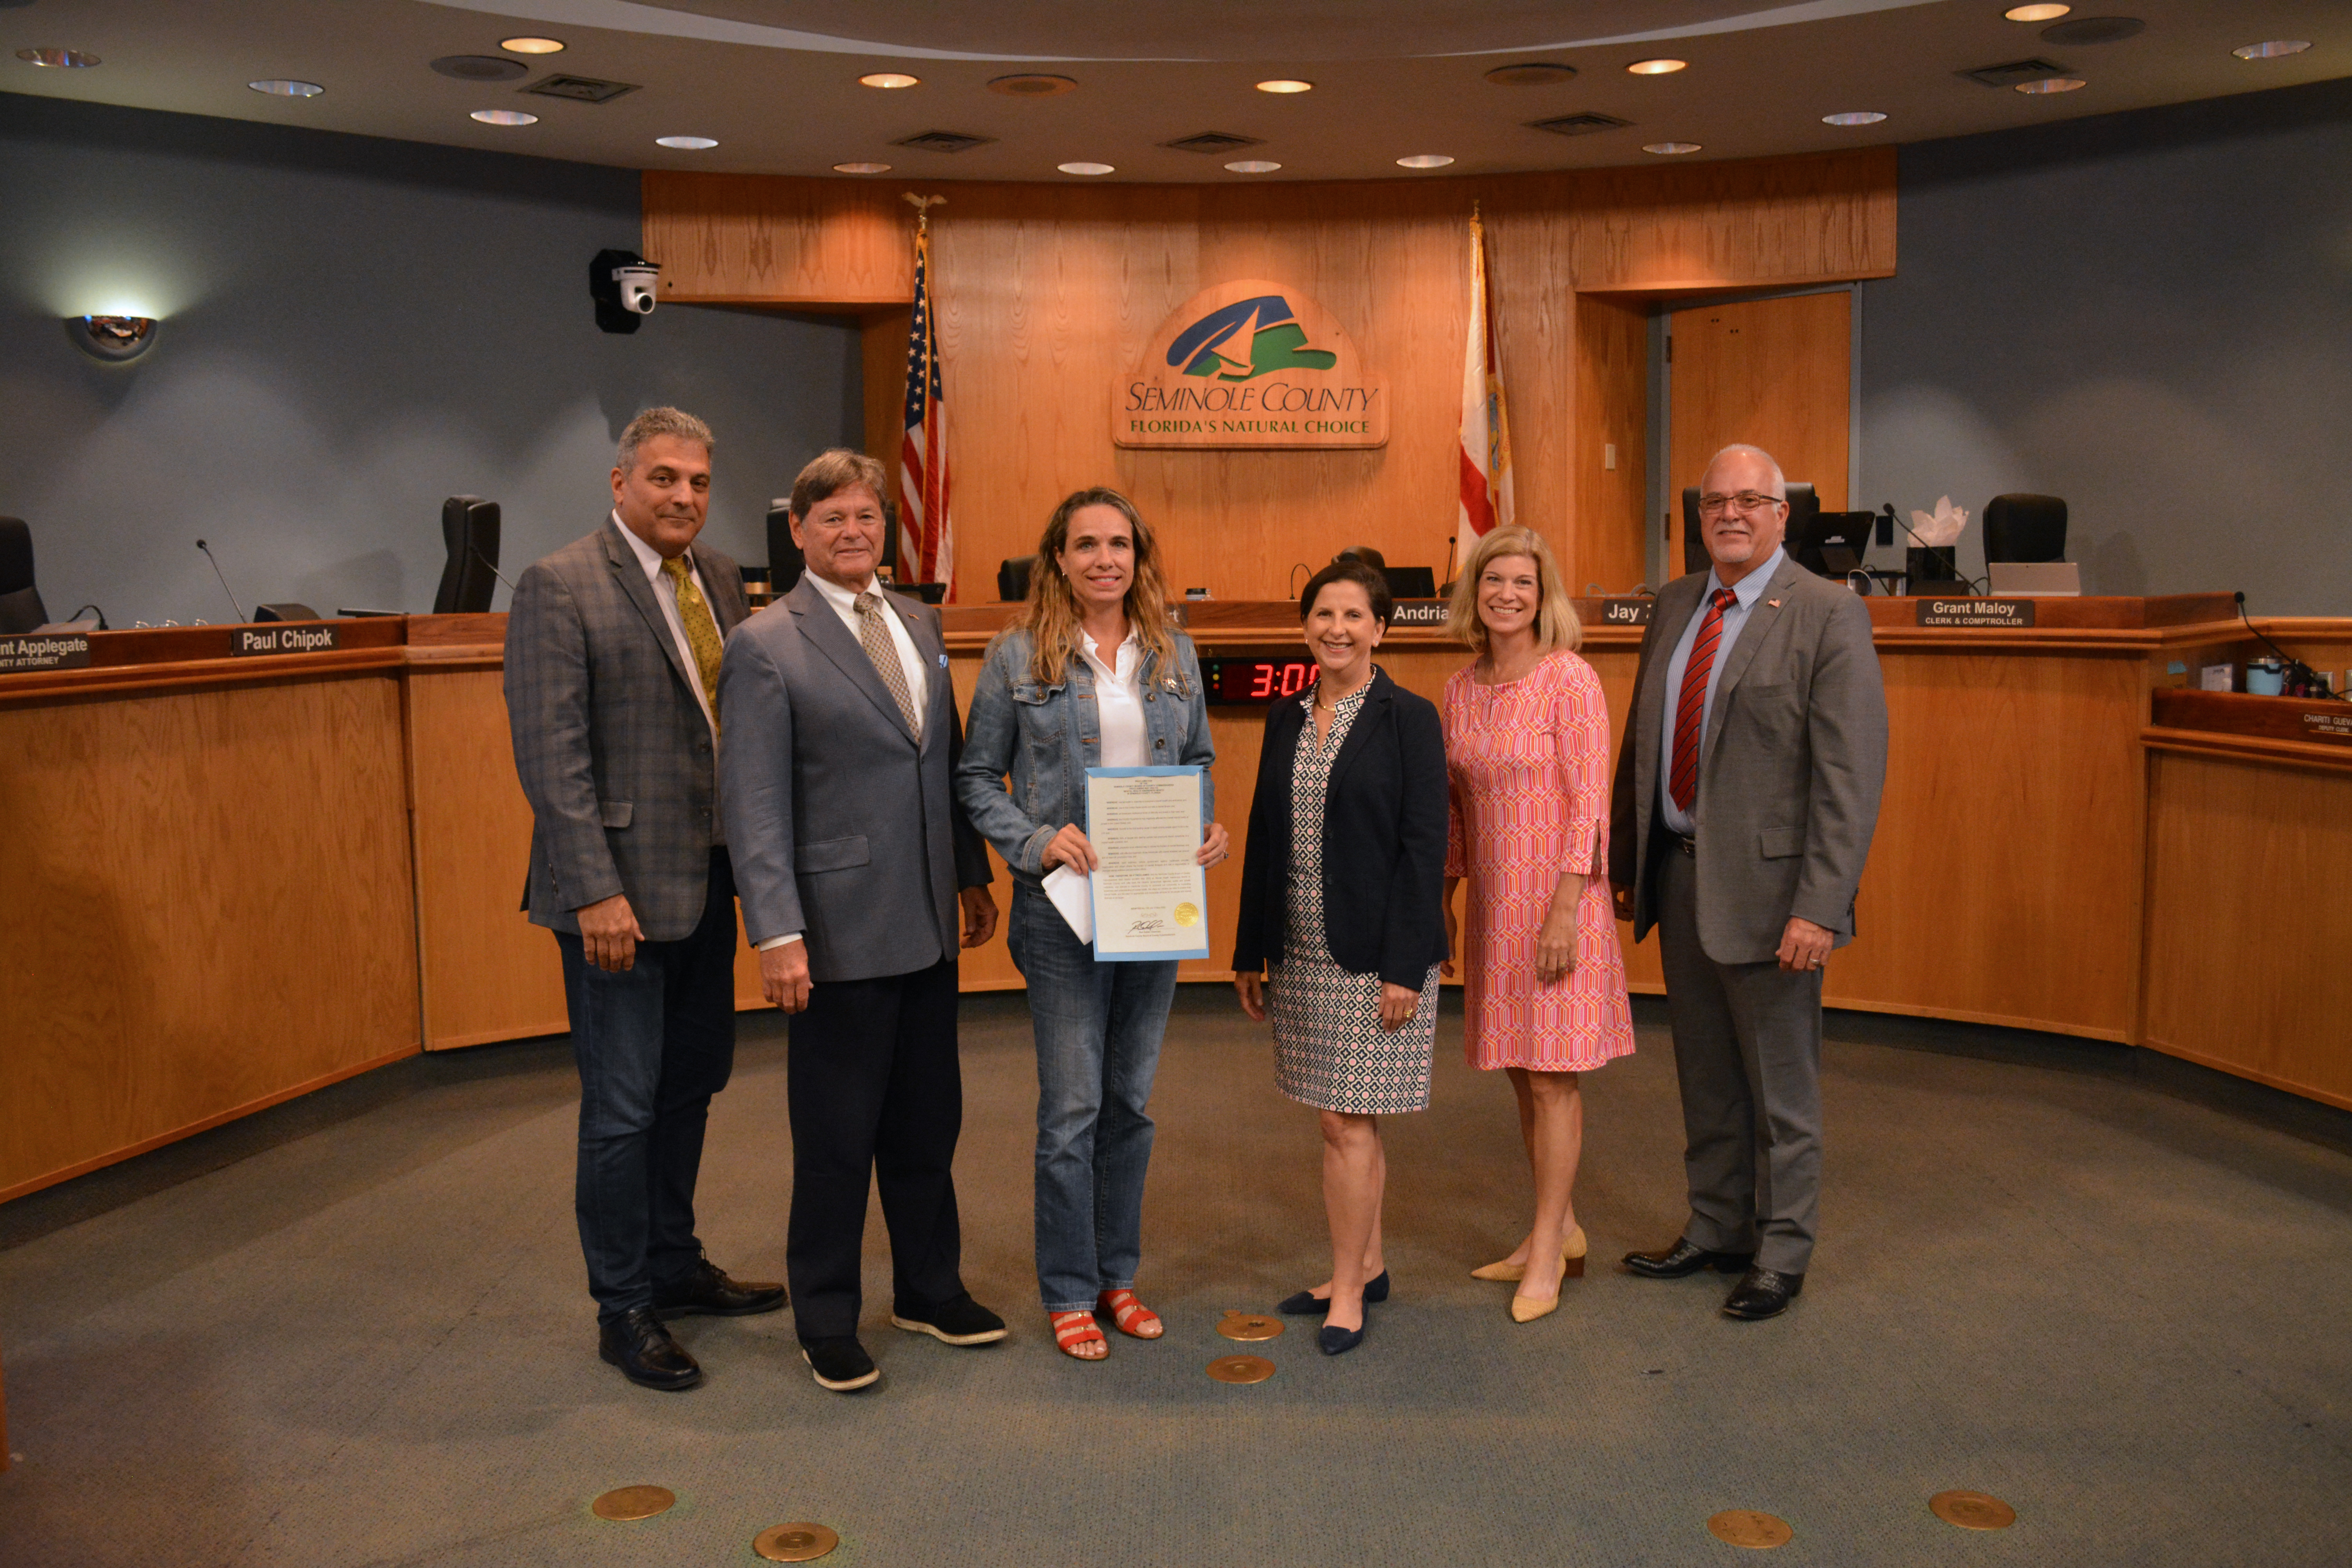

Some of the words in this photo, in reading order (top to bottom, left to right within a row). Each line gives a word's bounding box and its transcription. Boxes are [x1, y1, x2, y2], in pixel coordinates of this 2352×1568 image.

[1125, 382, 1254, 411] SEMINOLE
[1261, 383, 1378, 412] COUNTY
[1131, 420, 1217, 433] FLORIDA'S
[1223, 420, 1298, 434] NATURAL
[1305, 420, 1369, 434] CHOICE
[1393, 605, 1448, 620] Andria
[1608, 604, 1639, 622] Jay
[1933, 602, 1970, 613] Grant
[1975, 602, 2015, 617] Maloy
[0, 641, 15, 655] nt
[18, 638, 88, 657] Applegate
[243, 631, 276, 650] Paul
[282, 628, 332, 651] Chipok
[16, 656, 59, 666] ATTORNEY
